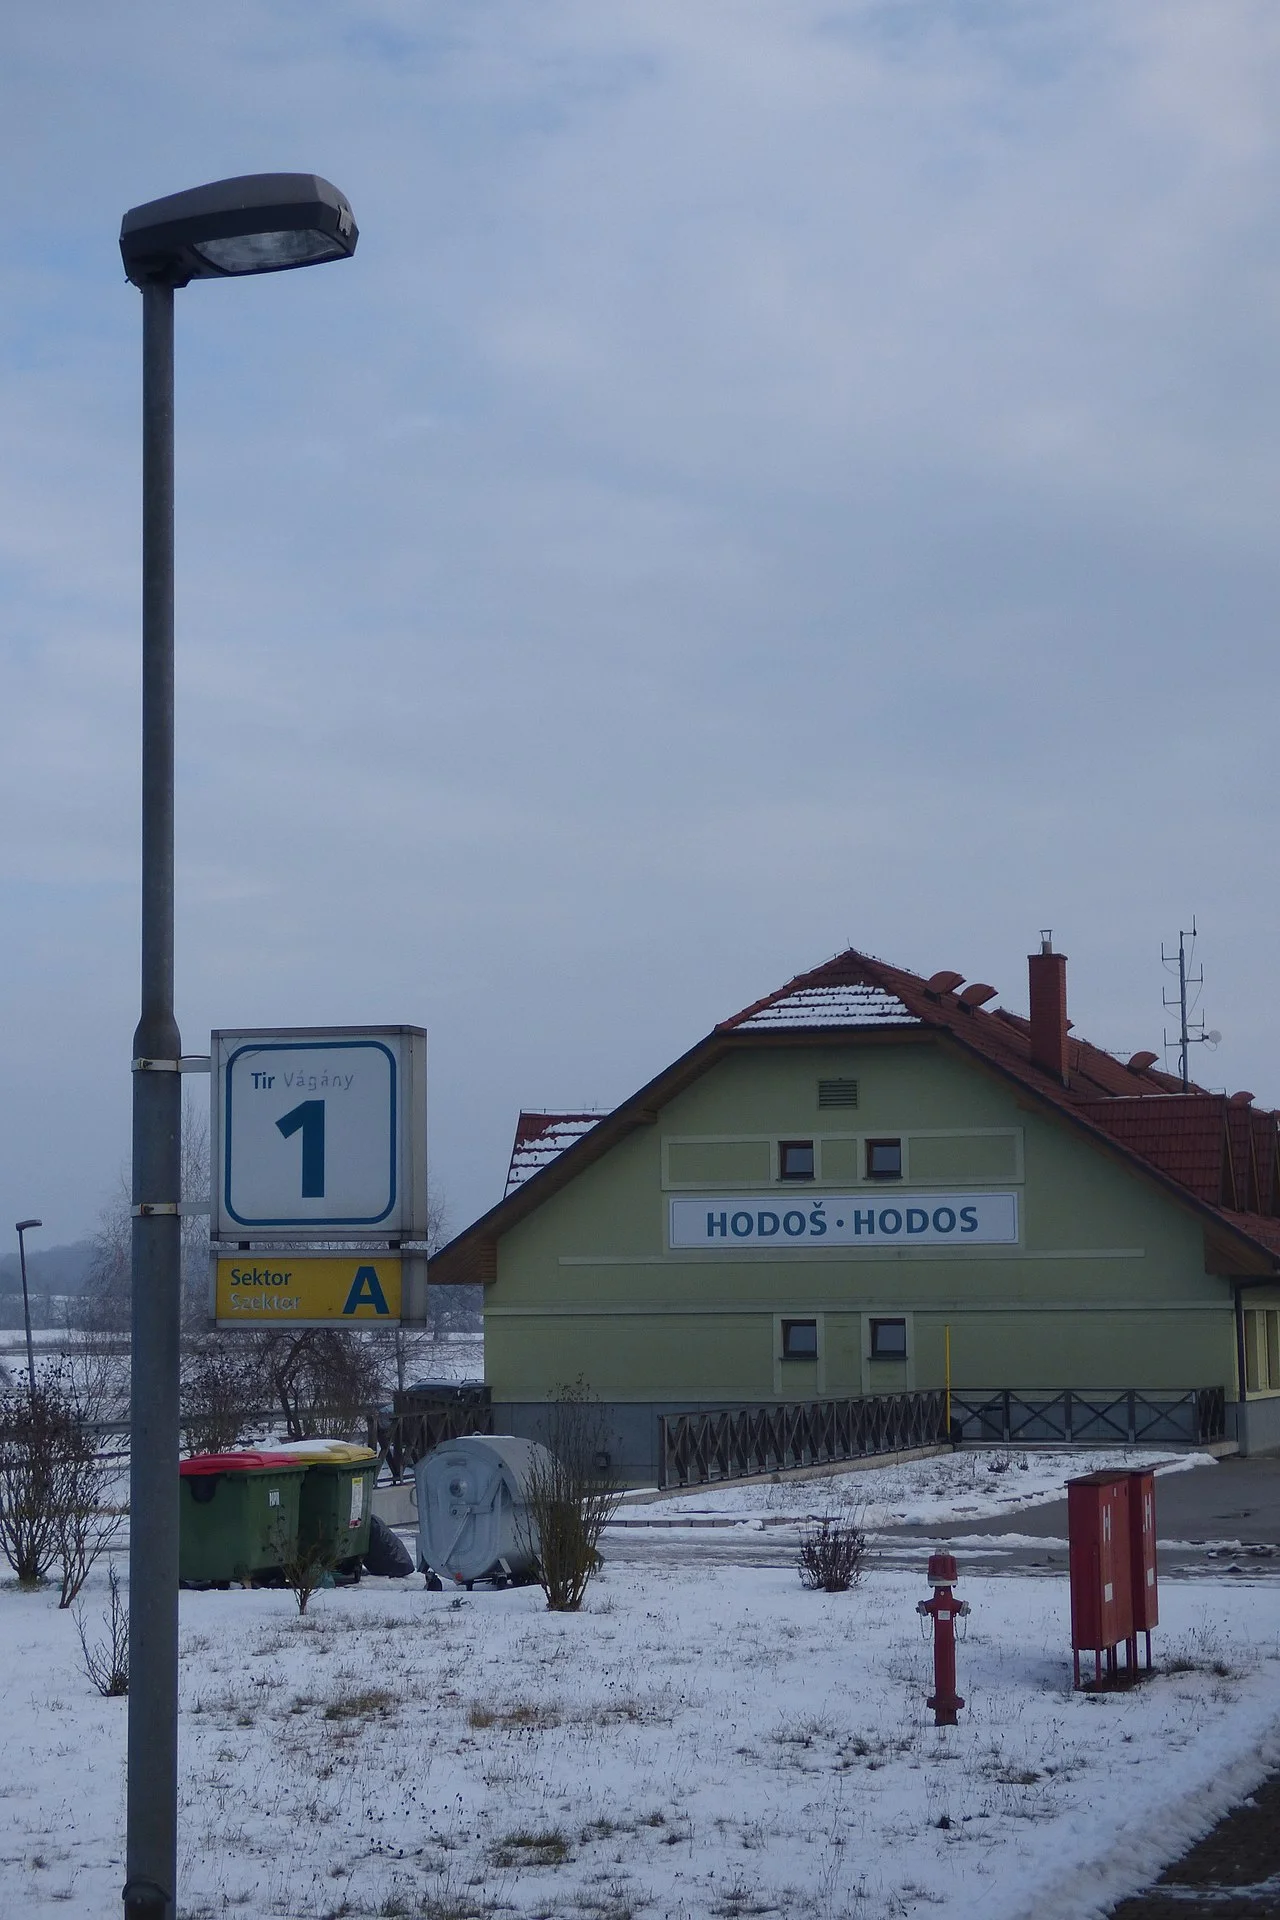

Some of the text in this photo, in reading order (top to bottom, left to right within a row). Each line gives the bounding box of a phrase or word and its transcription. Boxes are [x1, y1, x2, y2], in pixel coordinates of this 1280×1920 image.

[250, 1070, 354, 1091] Tir Vágány
[275, 1099, 326, 1199] 1
[706, 1201, 979, 1238] HODOŠ HODOS
[230, 1268, 292, 1287] Sektor
[342, 1265, 390, 1315] A
[230, 1292, 301, 1312] Szektor
